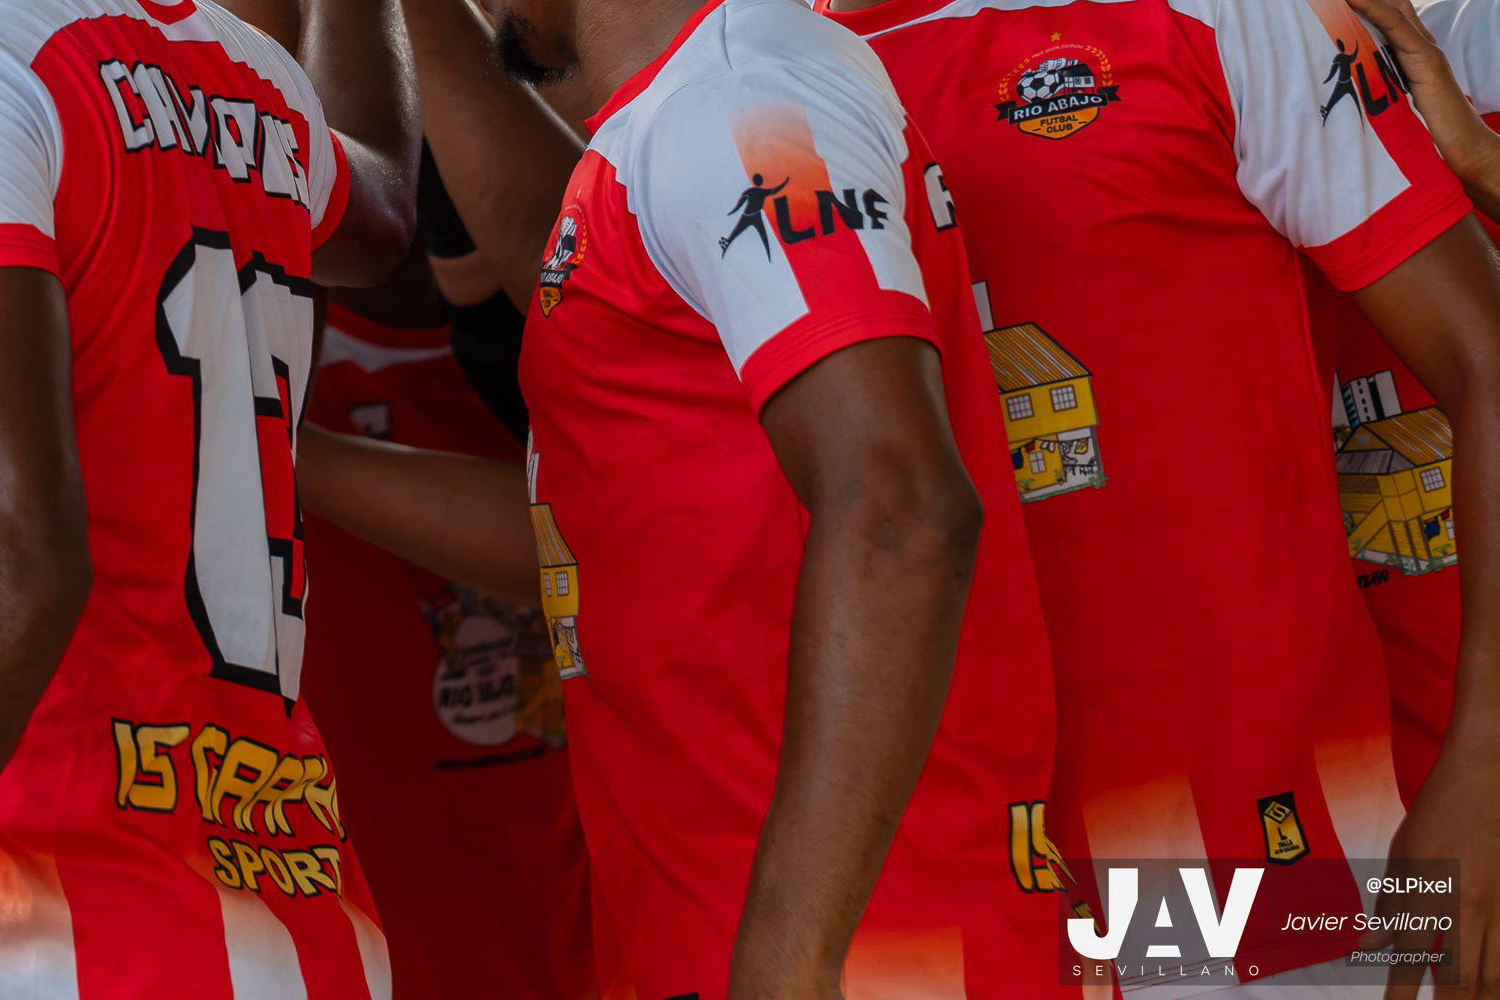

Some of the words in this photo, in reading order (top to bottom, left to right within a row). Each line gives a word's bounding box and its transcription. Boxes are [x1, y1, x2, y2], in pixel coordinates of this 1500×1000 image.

[1014, 105, 1042, 120] RIO
[1048, 96, 1102, 112] ABAJO
[1040, 114, 1079, 127] FUTSAL
[1045, 123, 1074, 134] CLUB
[772, 187, 891, 246] LNF
[206, 835, 343, 900] SPORT
